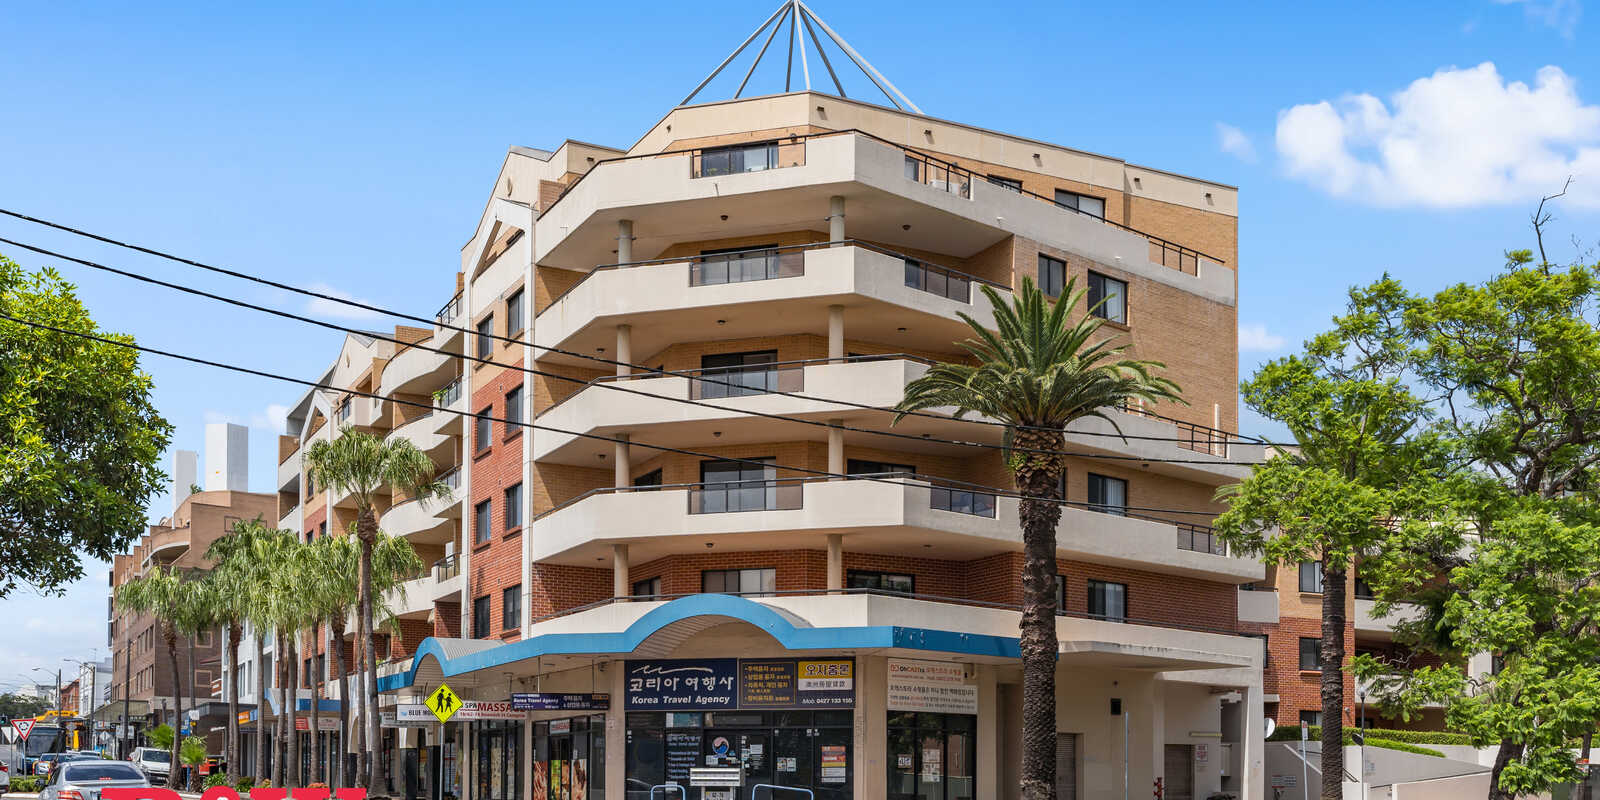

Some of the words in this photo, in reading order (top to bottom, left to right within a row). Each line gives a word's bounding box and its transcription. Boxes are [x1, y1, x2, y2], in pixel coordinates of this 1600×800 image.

[629, 676, 680, 692] 코리아
[685, 676, 734, 692] 여행사
[631, 696, 659, 704] Korea
[663, 695, 691, 704] Travel
[695, 695, 730, 705] Agency
[408, 709, 421, 717] BLUE
